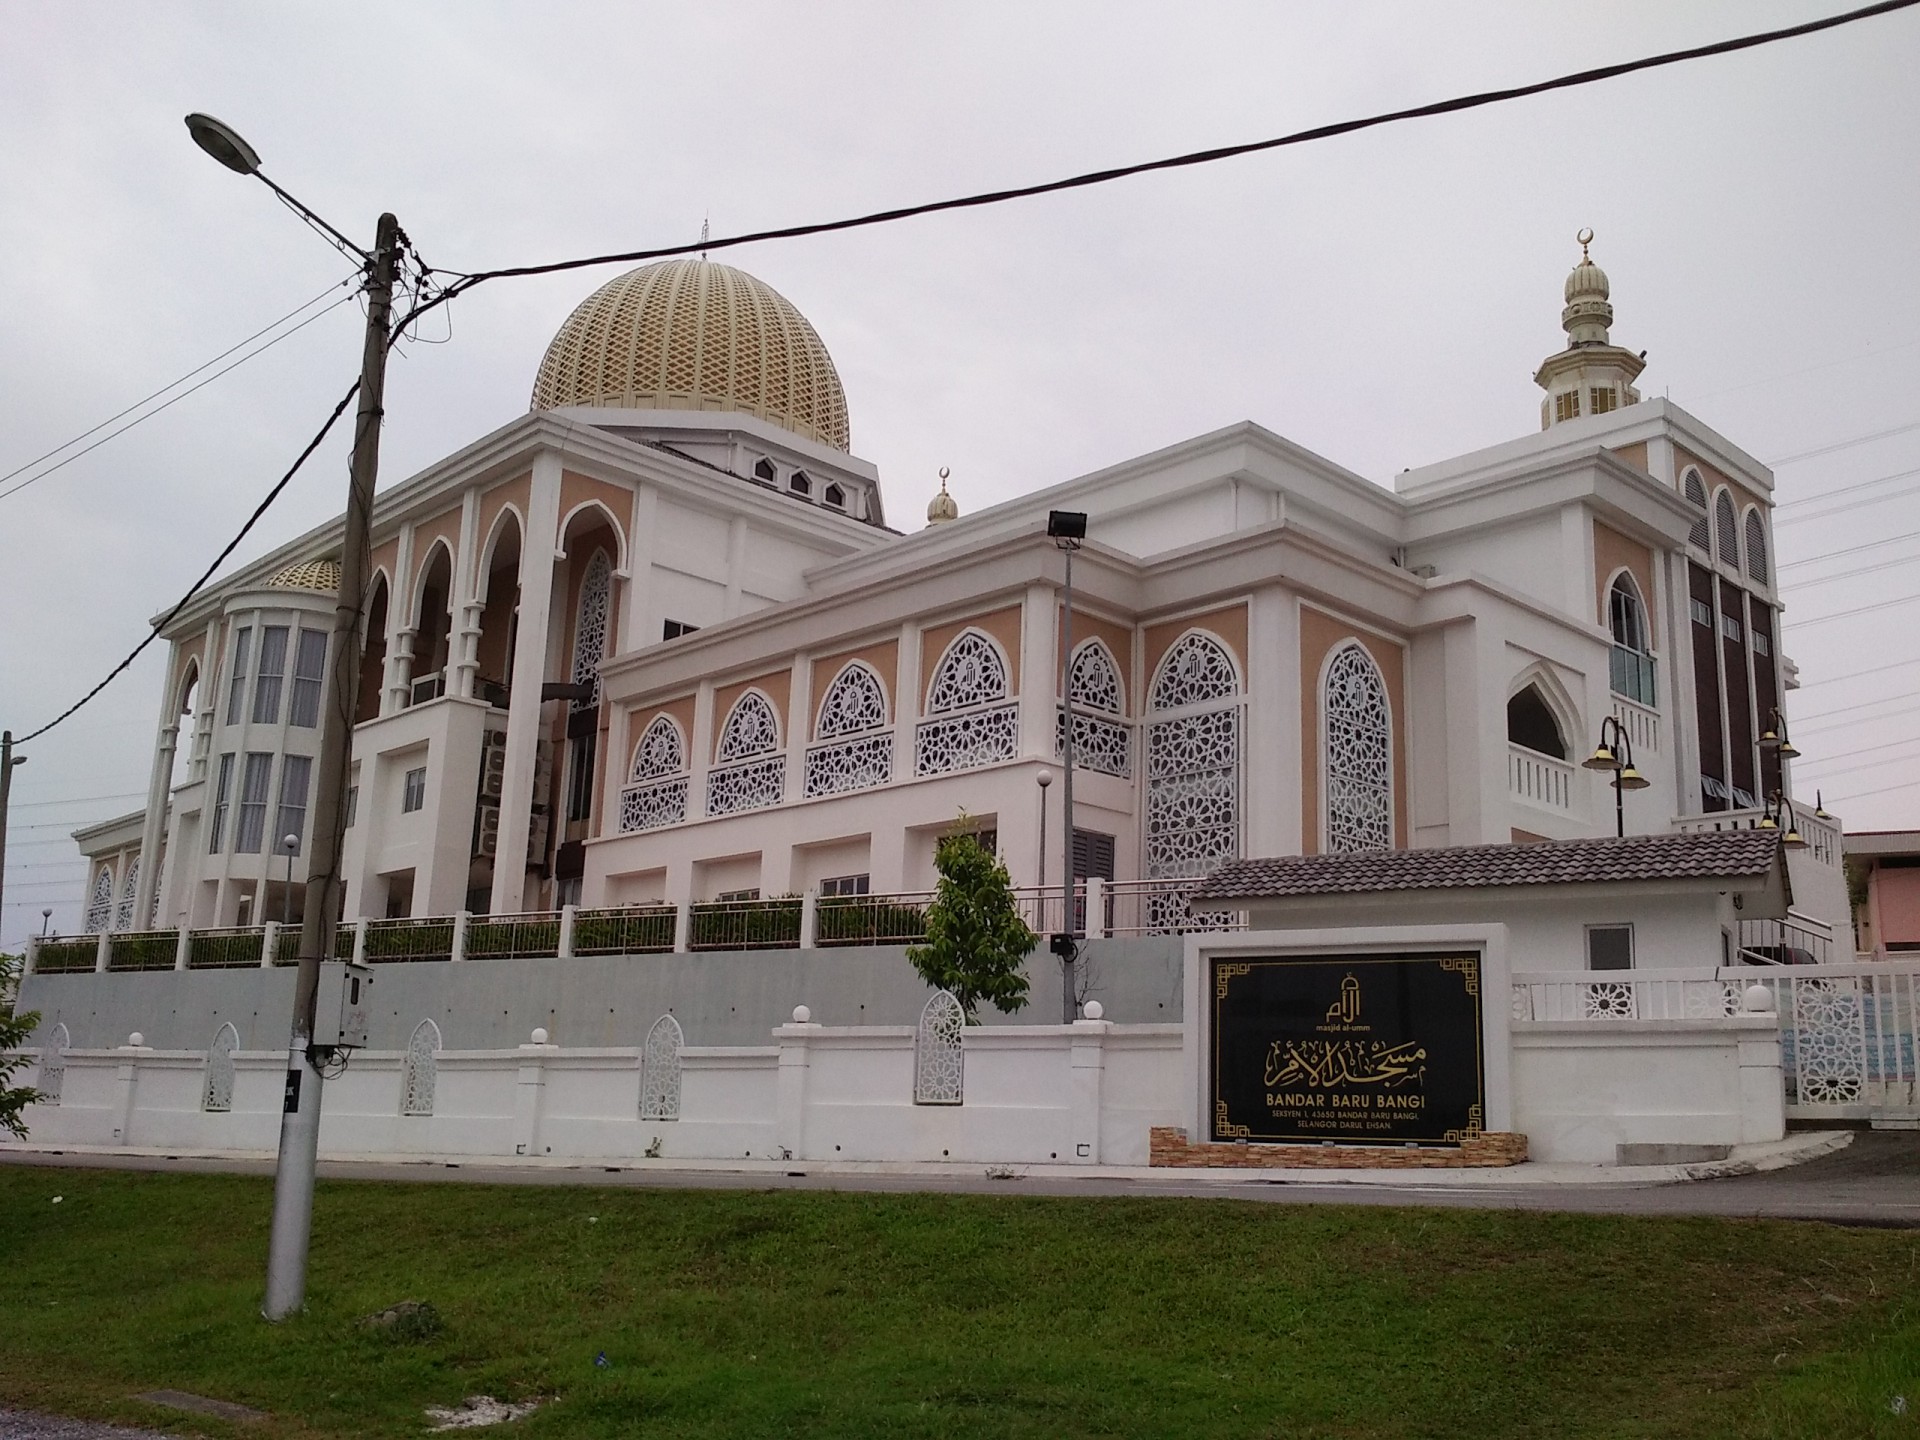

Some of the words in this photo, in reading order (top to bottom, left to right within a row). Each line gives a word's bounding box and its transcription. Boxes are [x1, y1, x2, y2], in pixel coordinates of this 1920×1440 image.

[1316, 1024, 1341, 1032] masjid
[1266, 1093, 1325, 1107] BANDAR
[1332, 1094, 1370, 1107] BARU
[1377, 1095, 1426, 1109] BANGI
[1271, 1109, 1301, 1118] SEKSYEN
[1311, 1110, 1335, 1118] 43650
[1337, 1111, 1367, 1119] BANDAR
[1370, 1111, 1390, 1119] BARU
[1297, 1120, 1337, 1129] SELANGOR
[1339, 1120, 1364, 1129] DARUL
